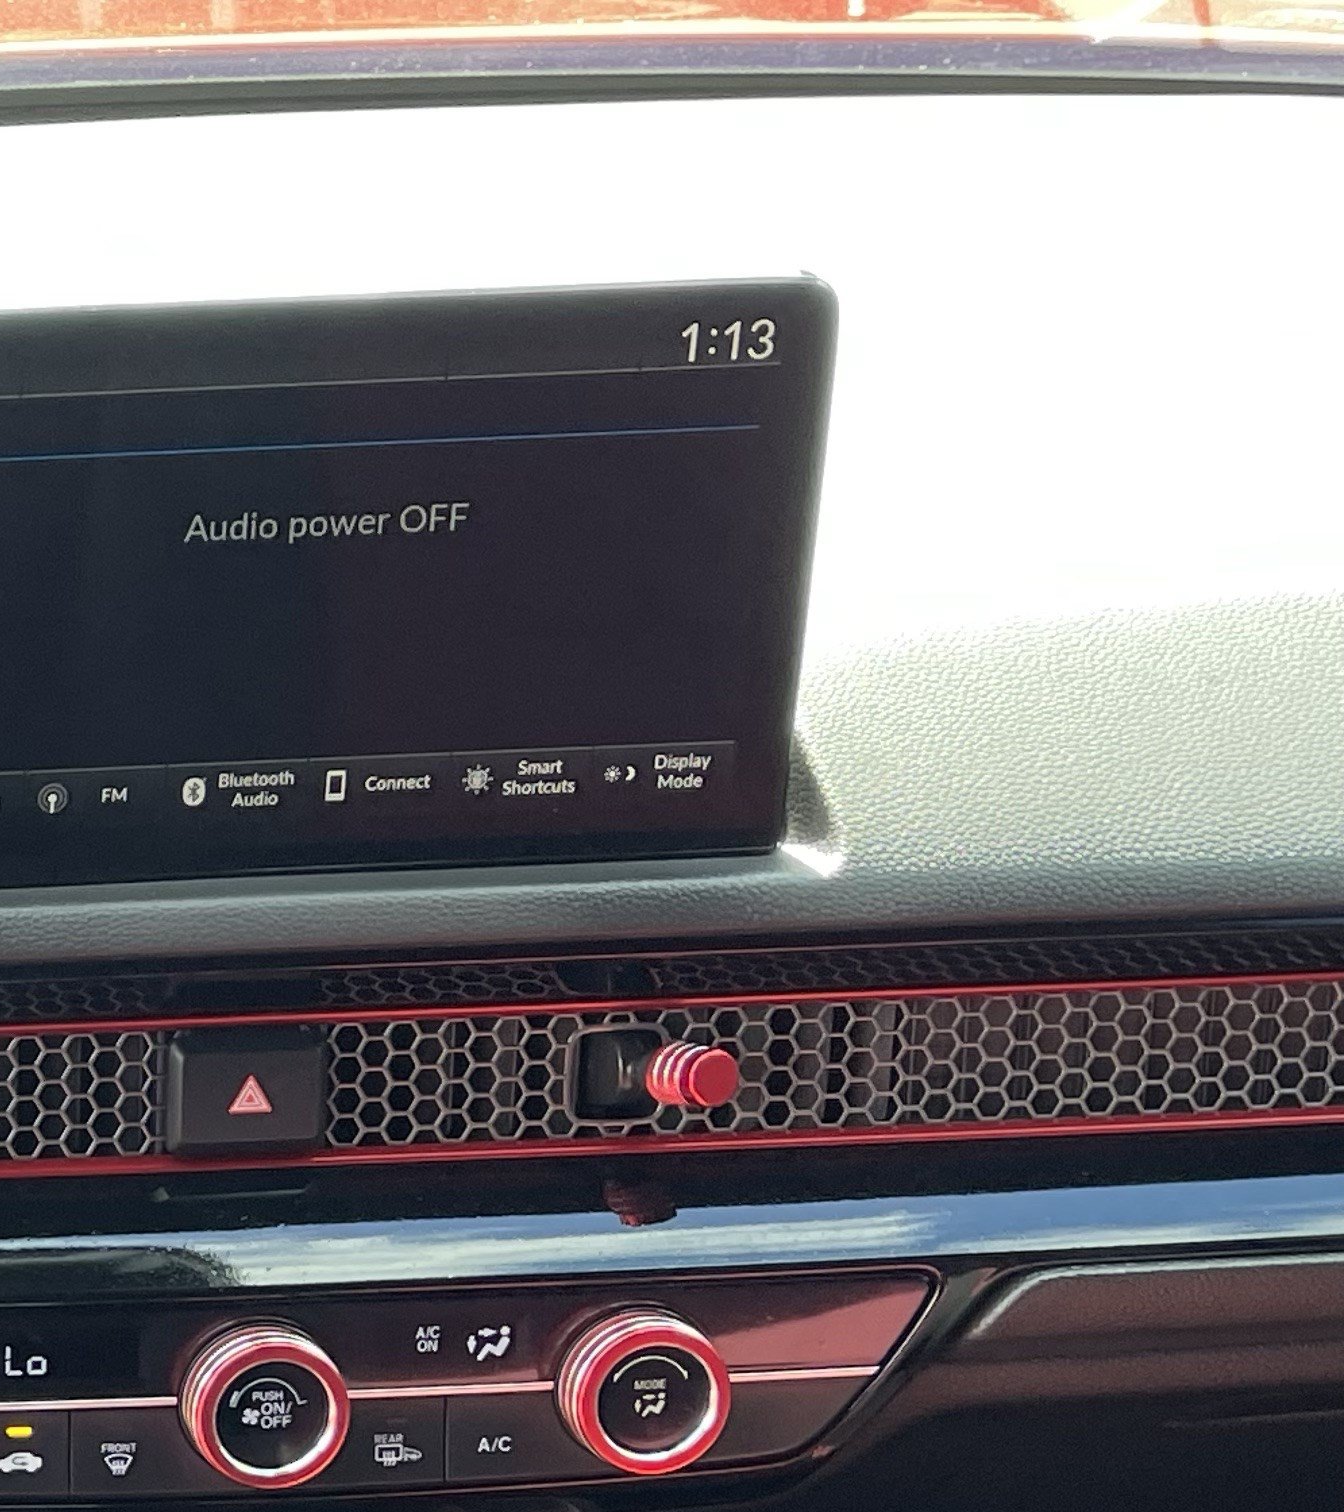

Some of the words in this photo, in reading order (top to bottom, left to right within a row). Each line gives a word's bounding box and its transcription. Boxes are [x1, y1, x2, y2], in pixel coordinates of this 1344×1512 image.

[681, 319, 776, 363] 1:13
[184, 514, 278, 543] Audio
[288, 514, 391, 544] power
[399, 502, 470, 533] OFF
[517, 759, 563, 776] Smart
[653, 753, 712, 773] Display
[218, 771, 295, 789] Bluetooth
[365, 774, 432, 792] Connect
[502, 778, 576, 797] Shortcuts
[657, 773, 704, 790] Mode
[101, 787, 128, 803] FM
[231, 791, 279, 808] Audio
[415, 1325, 441, 1339] A/C
[416, 1339, 439, 1353] ON
[4, 1345, 48, 1376] Lo
[633, 1378, 666, 1392] MODE
[252, 1390, 284, 1402] PUSH
[260, 1414, 293, 1430] OFF
[373, 1433, 404, 1445] REAR
[477, 1436, 512, 1452] A/C
[100, 1442, 137, 1454] FRONT
